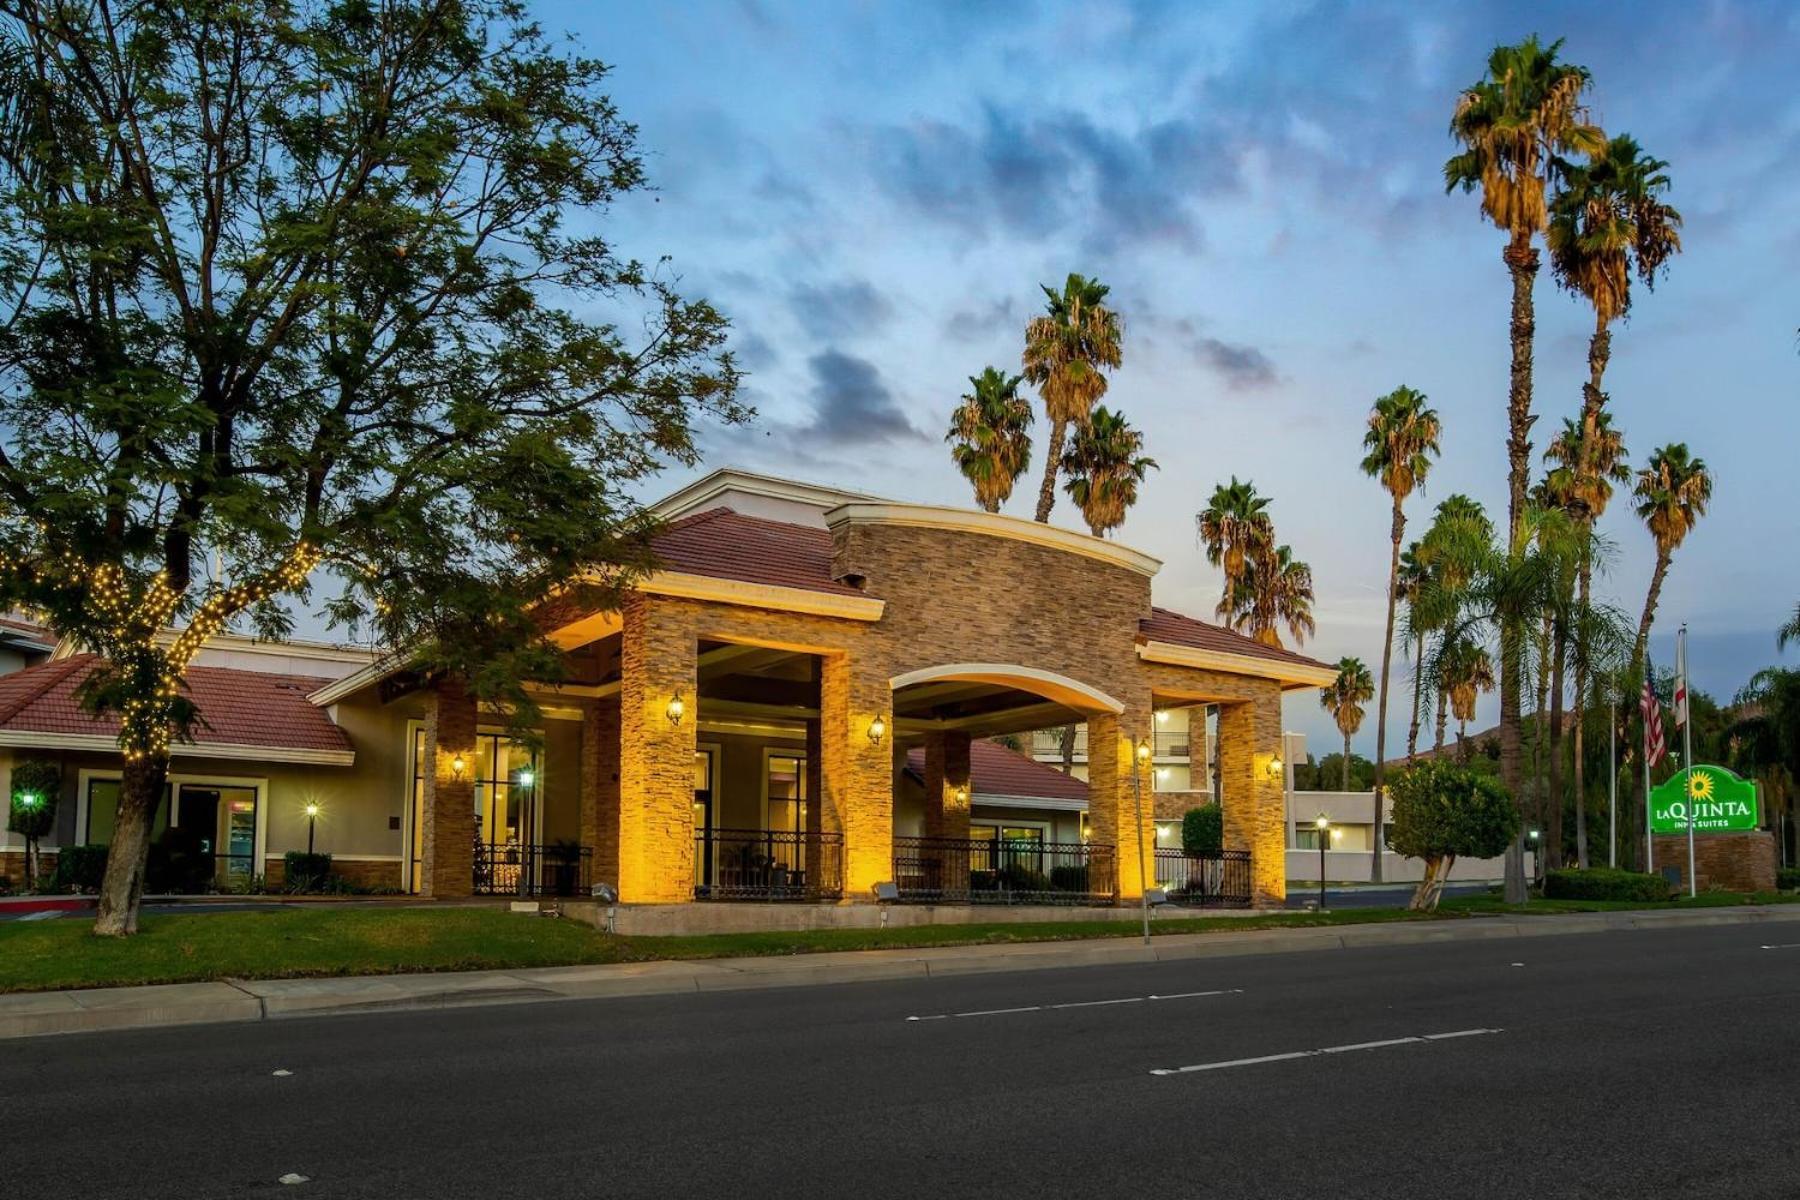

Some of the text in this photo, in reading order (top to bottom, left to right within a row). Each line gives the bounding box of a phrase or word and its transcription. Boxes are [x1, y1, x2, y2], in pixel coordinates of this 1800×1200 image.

[1656, 801, 1751, 821] LA QUINTA
[1697, 820, 1729, 828] SUITES
